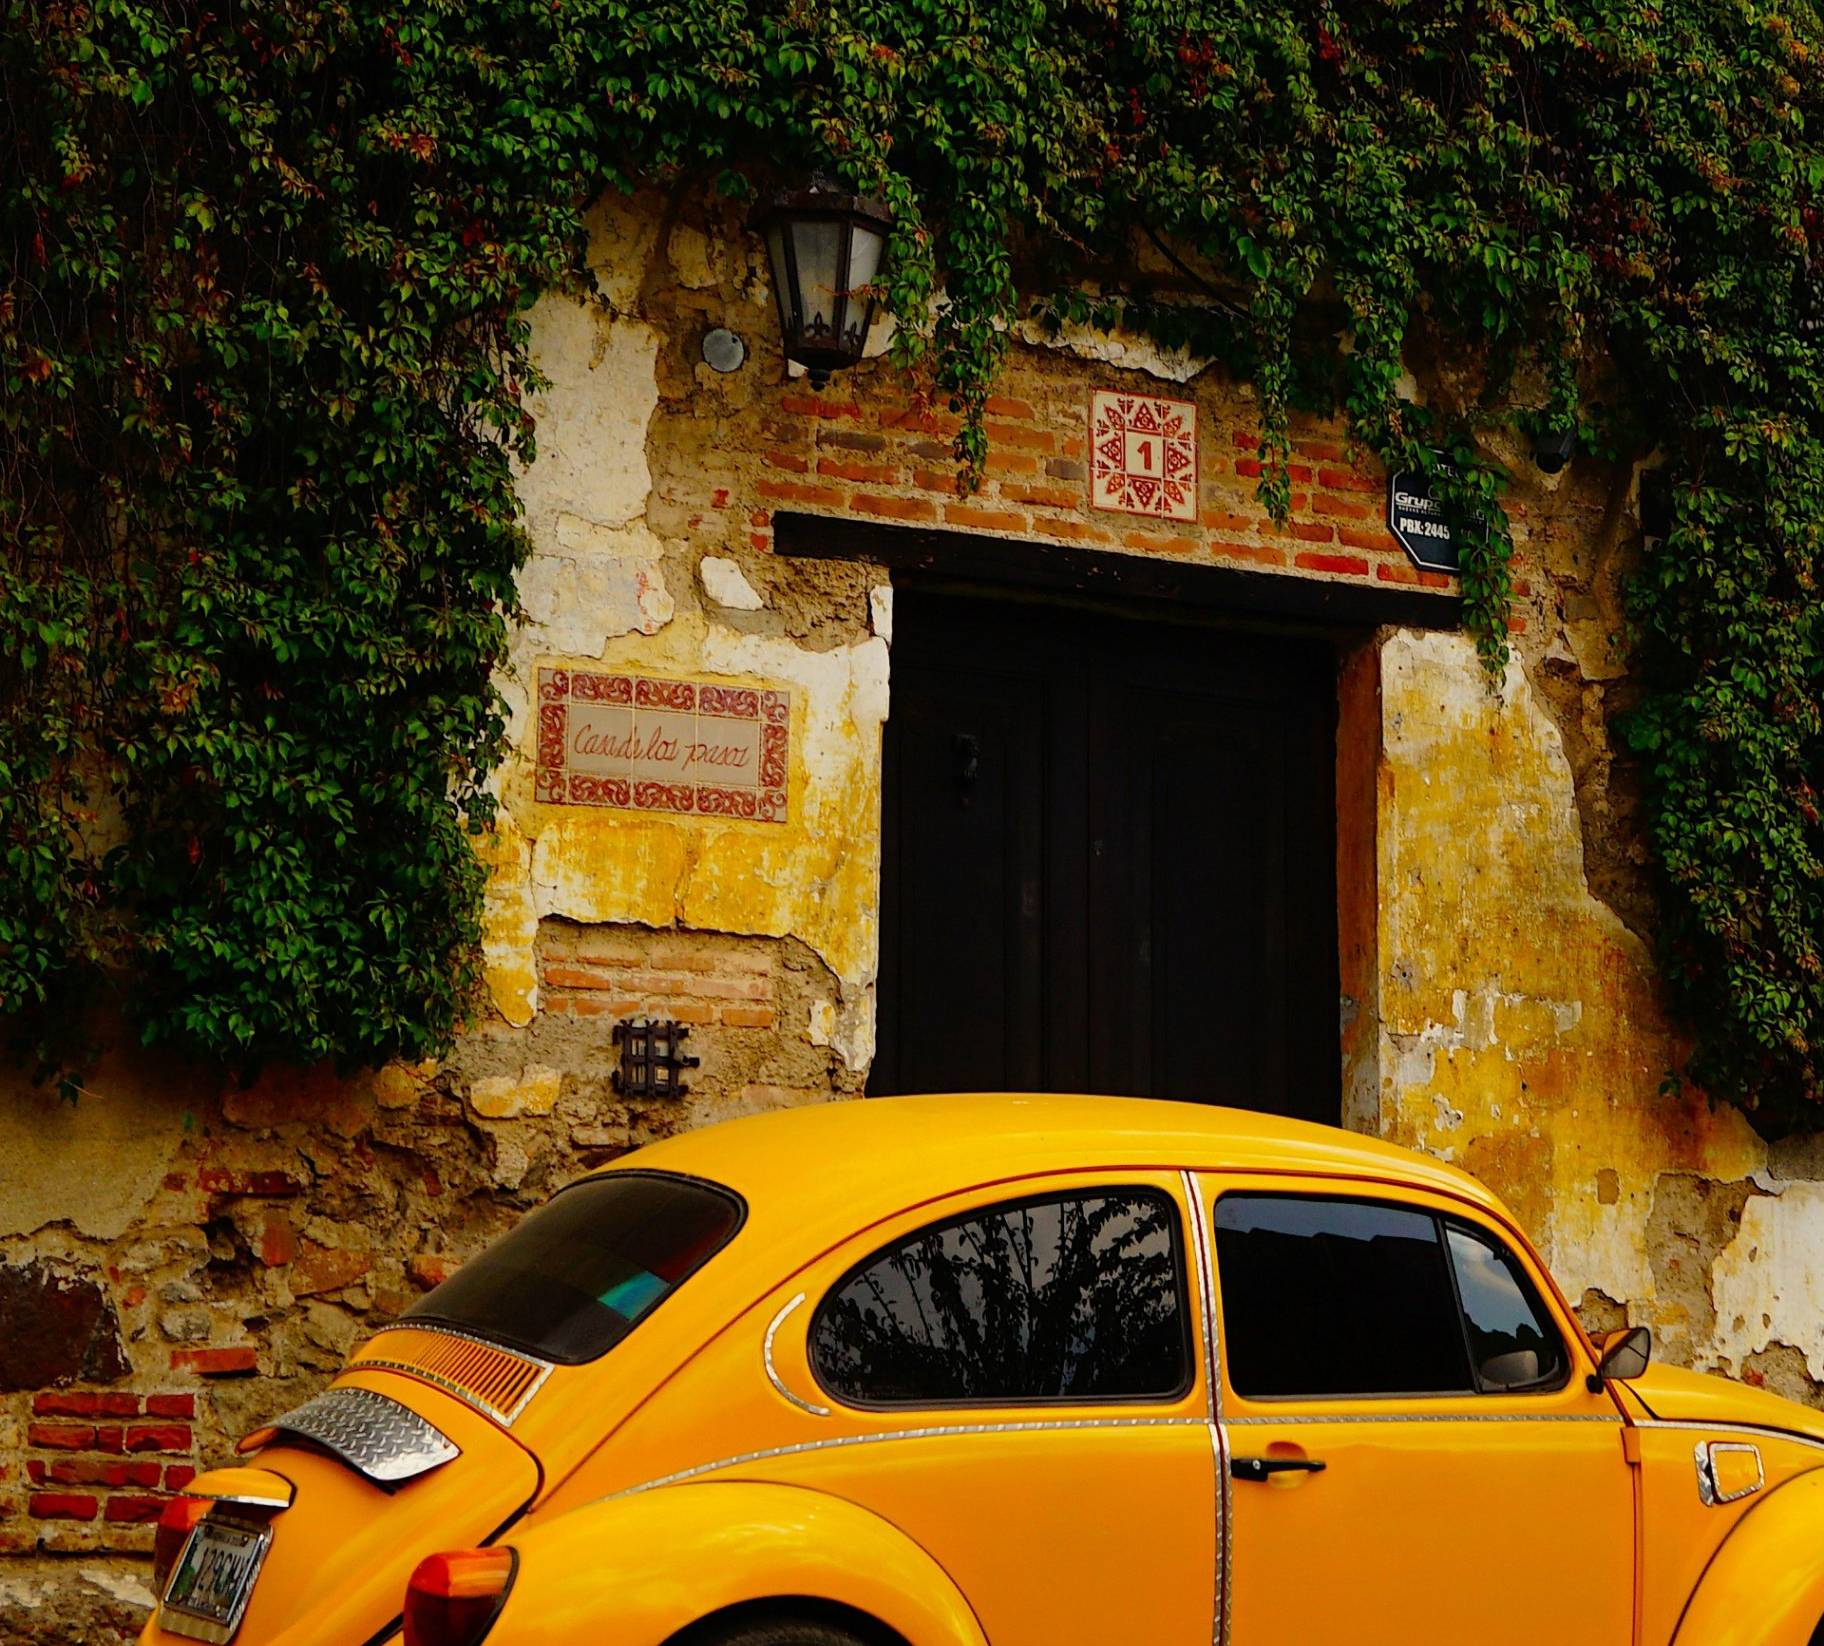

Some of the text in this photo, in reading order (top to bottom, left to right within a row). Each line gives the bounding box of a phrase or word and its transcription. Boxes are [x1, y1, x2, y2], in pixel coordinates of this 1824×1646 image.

[1136, 440, 1152, 470] 1
[1424, 521, 1450, 540] 2445
[645, 725, 680, 761] los
[683, 744, 750, 771] pasos
